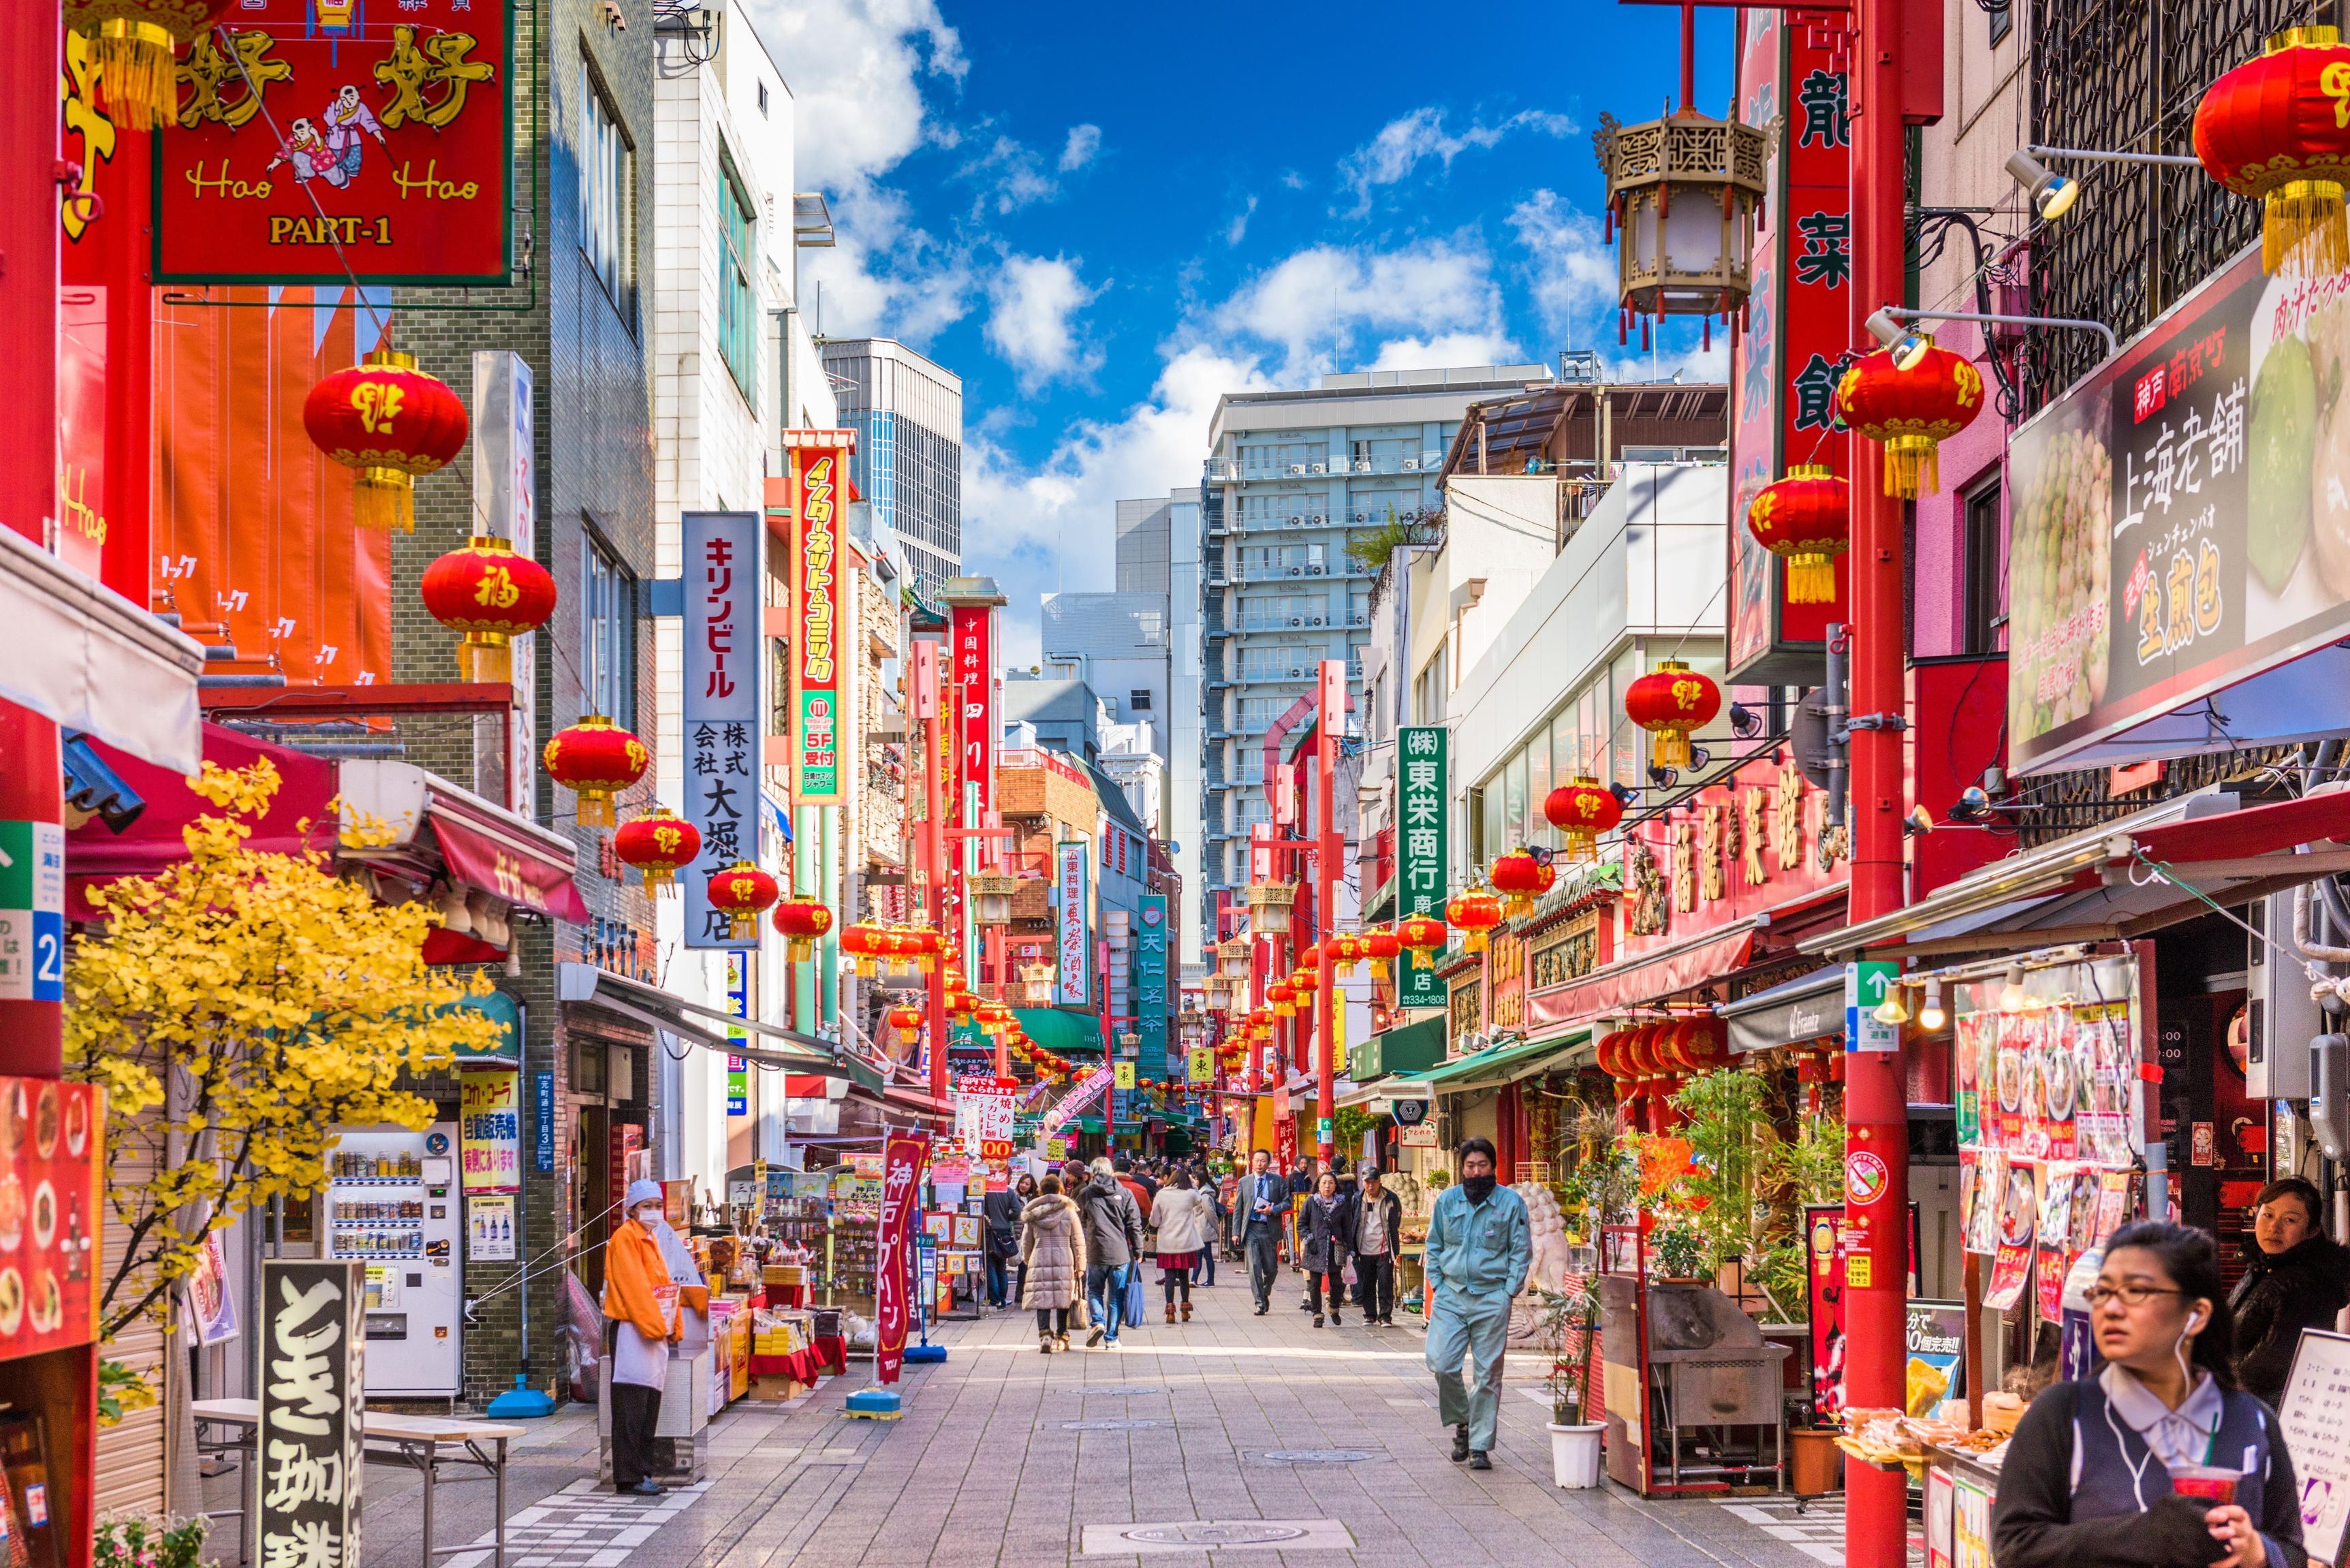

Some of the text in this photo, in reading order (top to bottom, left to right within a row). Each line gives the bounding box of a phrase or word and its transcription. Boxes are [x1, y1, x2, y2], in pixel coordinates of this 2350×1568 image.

[374, 24, 496, 130] 好
[186, 159, 272, 200] Hao
[392, 159, 479, 200] Hao
[269, 216, 392, 245] PART-1
[2167, 324, 2227, 400] 南京町
[2136, 371, 2164, 415] 神戸
[61, 462, 107, 546] Hao
[475, 565, 519, 608] 福
[2138, 538, 2221, 665] 生煎包
[706, 537, 735, 698] キリンビール
[964, 617, 980, 685] 中国料理
[805, 751, 834, 766] 受付
[807, 734, 832, 747] 5F
[1067, 849, 1078, 898] 広東料理
[1140, 934, 1165, 1033] 天仁茗茶
[1410, 995, 1446, 1005] 334-1808
[1797, 1011, 1819, 1035] Frantz
[960, 1077, 996, 1085] 店内でも
[1121, 1071, 1129, 1081] 東
[1195, 1060, 1208, 1072] 東
[959, 1085, 1014, 1095] 食べられます
[464, 1114, 517, 1140] 自動販売機
[999, 1097, 1012, 1139] 焼めし
[878, 1159, 913, 1329] 神戸プリン
